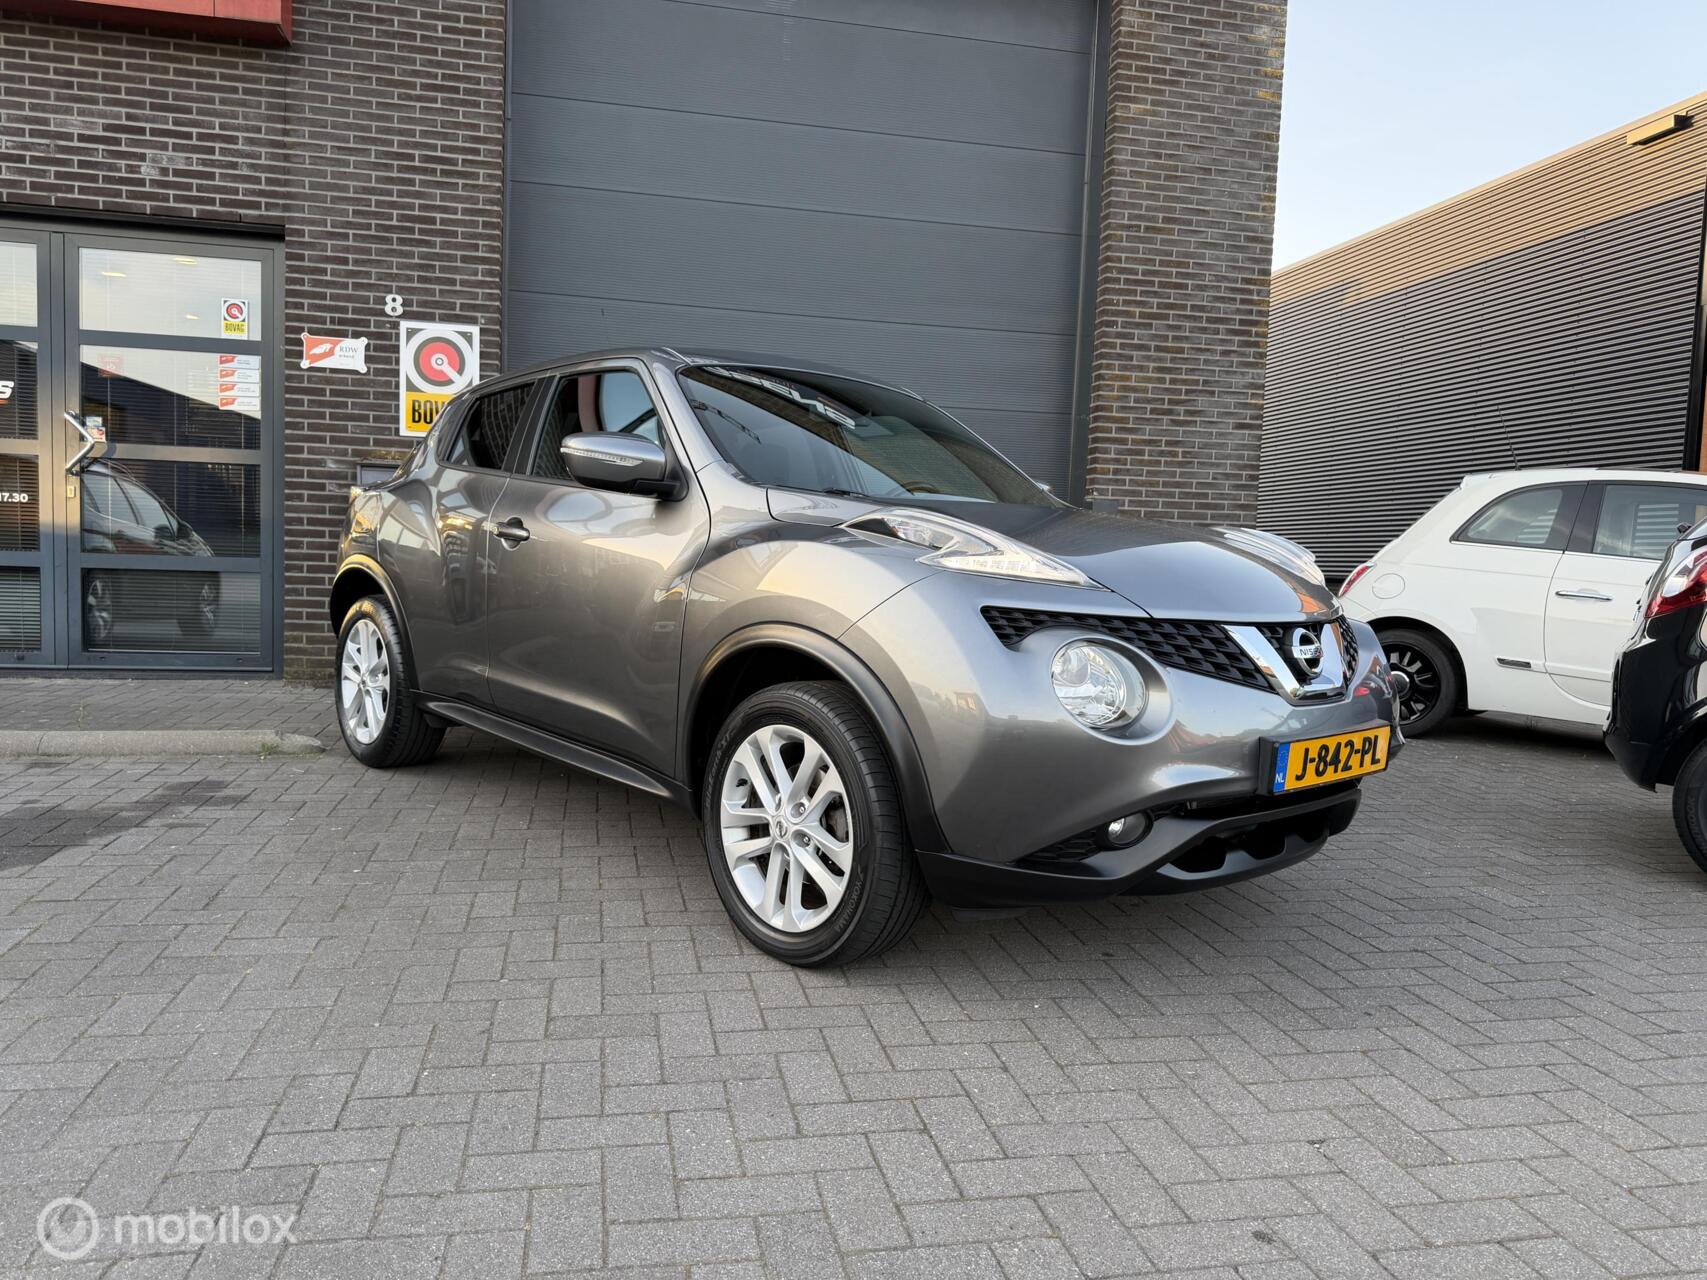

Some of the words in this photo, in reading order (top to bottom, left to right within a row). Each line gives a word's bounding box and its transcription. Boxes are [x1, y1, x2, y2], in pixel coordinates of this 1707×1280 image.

[384, 294, 404, 316] 8
[1295, 735, 1381, 781] J-842-PL
[1275, 773, 1285, 783] NL
